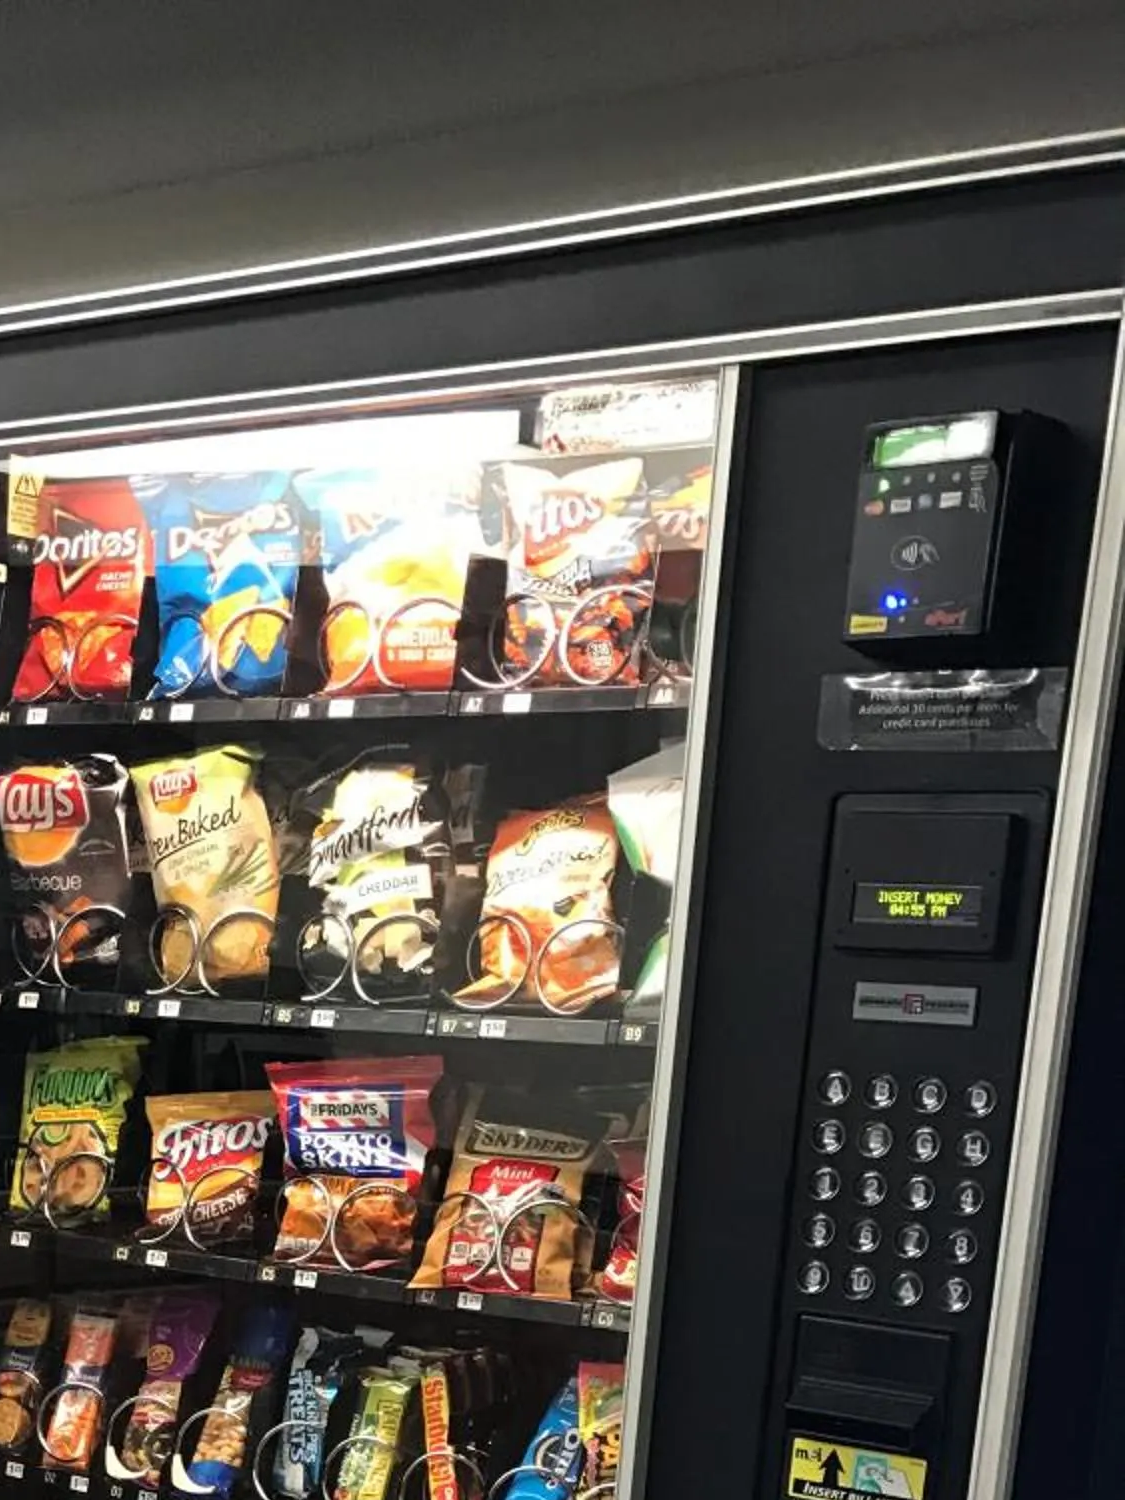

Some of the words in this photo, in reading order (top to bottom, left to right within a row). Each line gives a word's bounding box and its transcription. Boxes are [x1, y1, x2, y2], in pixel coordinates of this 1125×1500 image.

[177, 796, 242, 845] Baked
[878, 891, 919, 904] INSERT
[926, 892, 963, 905] MONEY
[931, 906, 948, 918] PM
[318, 1102, 378, 1117] FRIDAYS
[154, 1117, 274, 1180] Fritos
[300, 1133, 392, 1151] POTATO
[301, 1149, 389, 1170] SKINS
[490, 1164, 535, 1181] Mini
[192, 1186, 249, 1222] CHEESE
[288, 1369, 306, 1465] TREATS
[803, 1481, 848, 1500] INSERT
